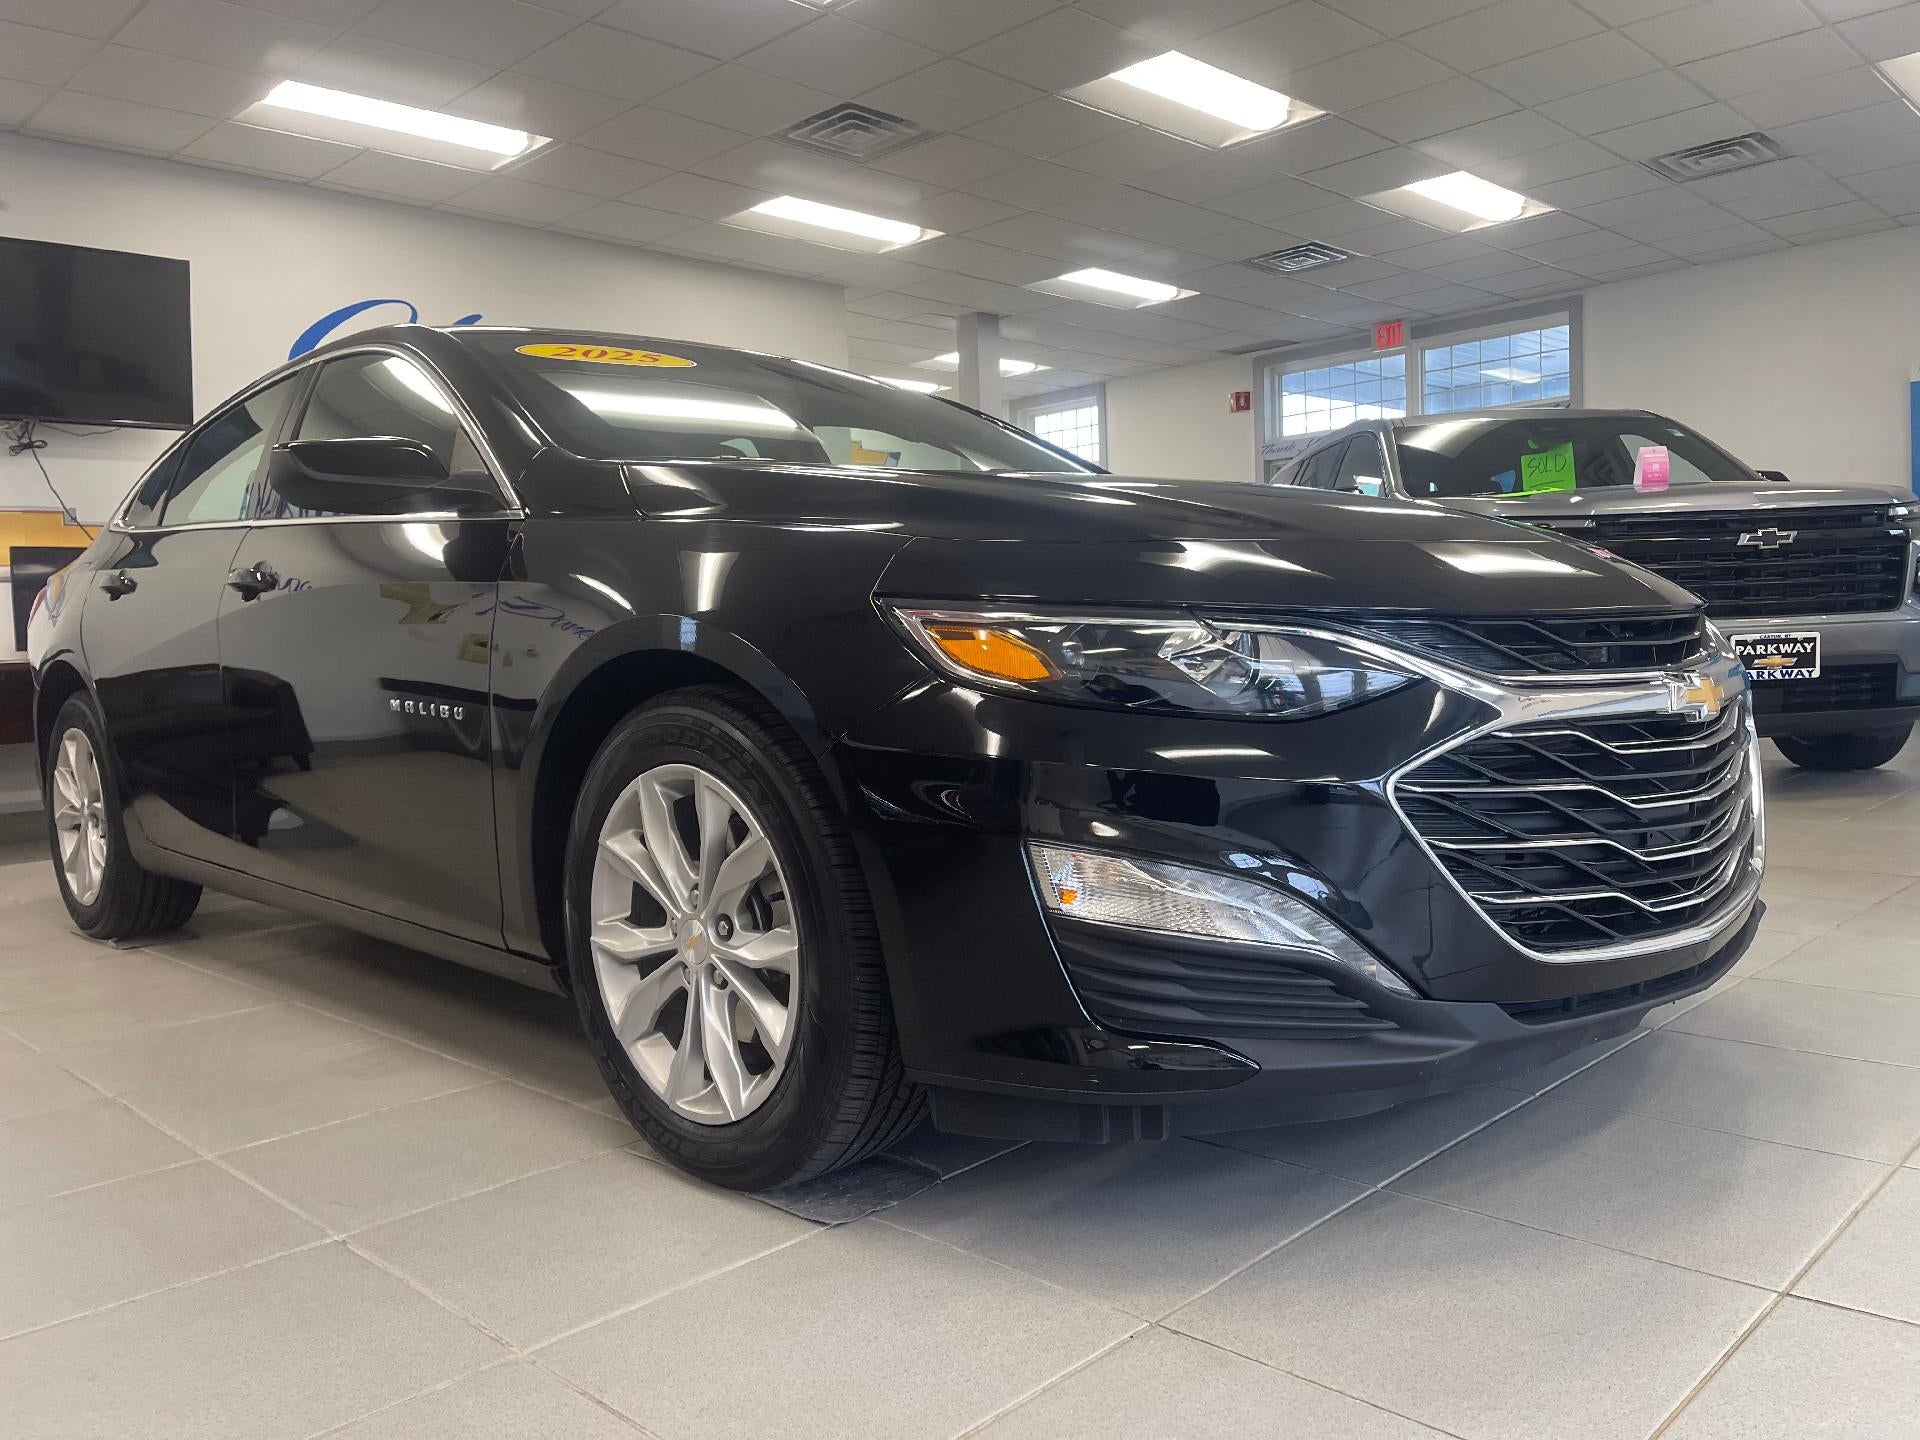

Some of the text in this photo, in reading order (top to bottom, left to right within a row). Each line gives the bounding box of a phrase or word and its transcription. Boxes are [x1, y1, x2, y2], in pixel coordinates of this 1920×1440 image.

[1377, 321, 1403, 349] EXIT
[553, 346, 661, 363] 2025
[1527, 453, 1567, 479] SOLD
[1736, 642, 1815, 656] PARKWAY
[1746, 669, 1815, 680] ARKWAY
[389, 699, 464, 720] MALIBU
